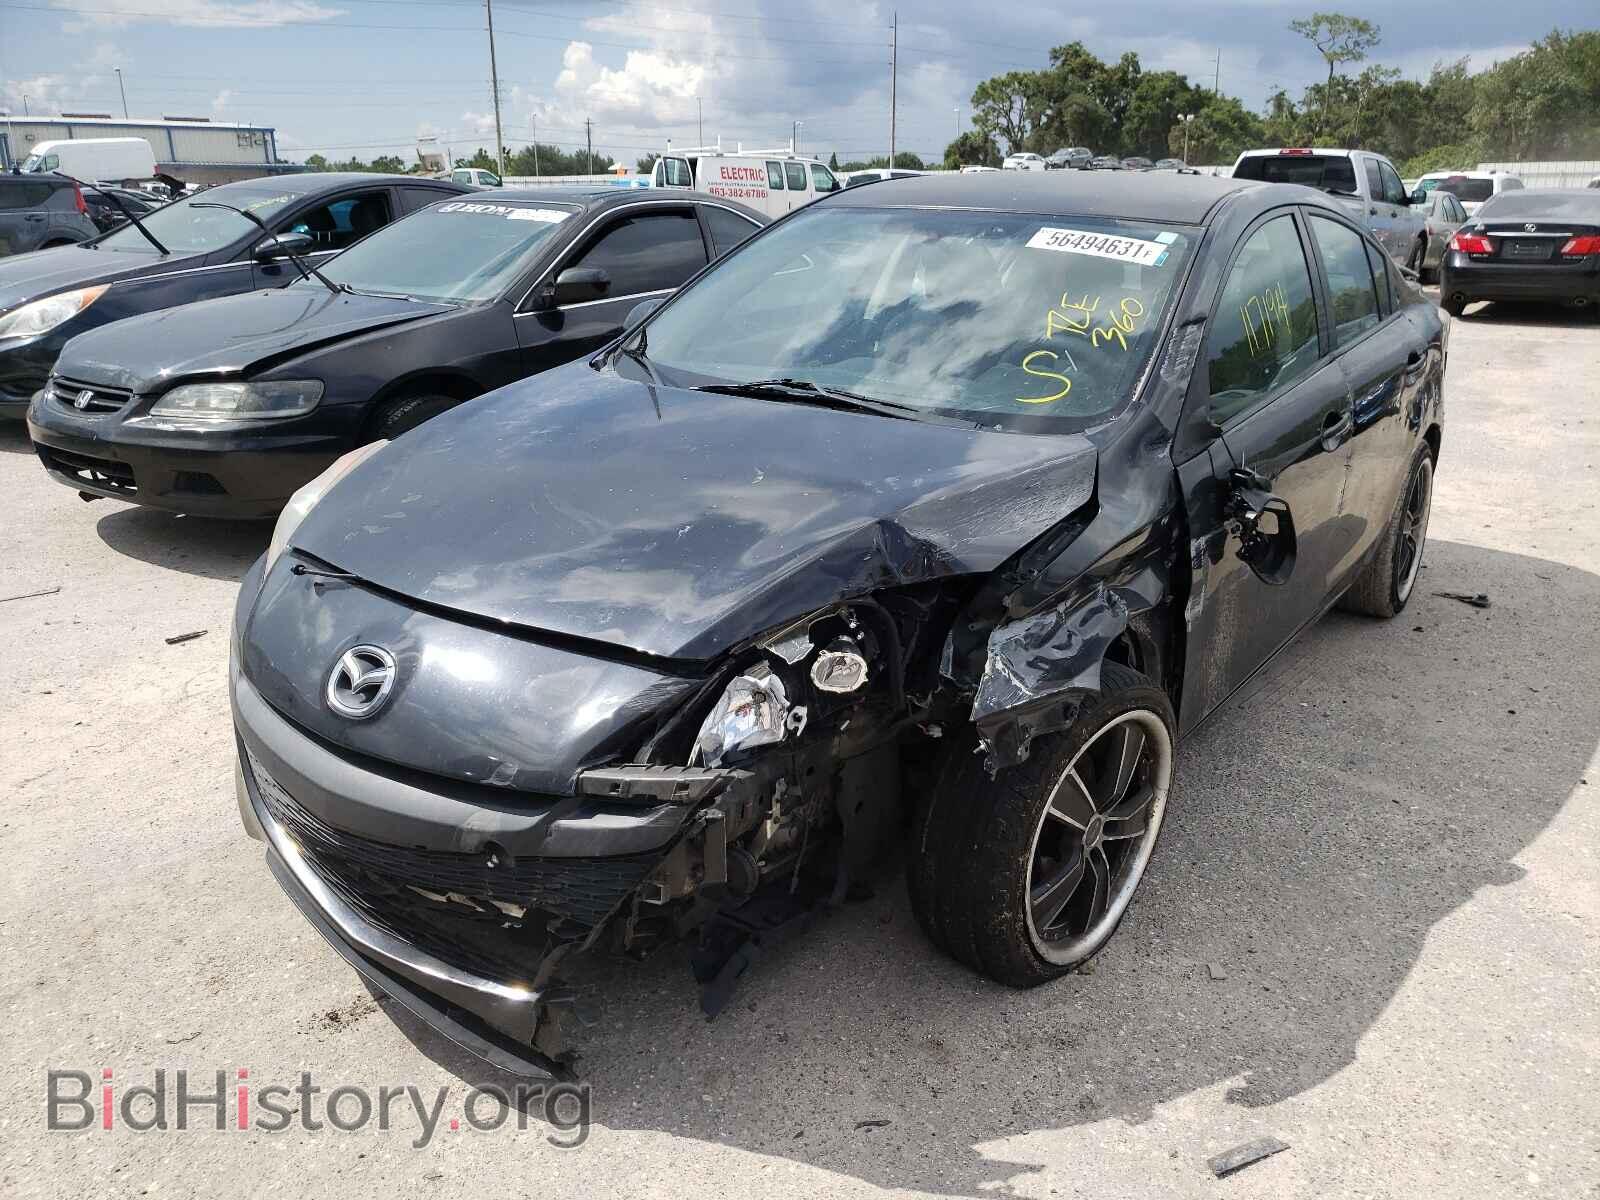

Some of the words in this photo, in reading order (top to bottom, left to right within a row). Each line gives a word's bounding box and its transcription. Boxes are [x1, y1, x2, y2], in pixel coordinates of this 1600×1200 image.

[720, 166, 765, 181] ELECTRIC
[1046, 232, 1144, 257] 56494631
[1092, 297, 1144, 351] 360
